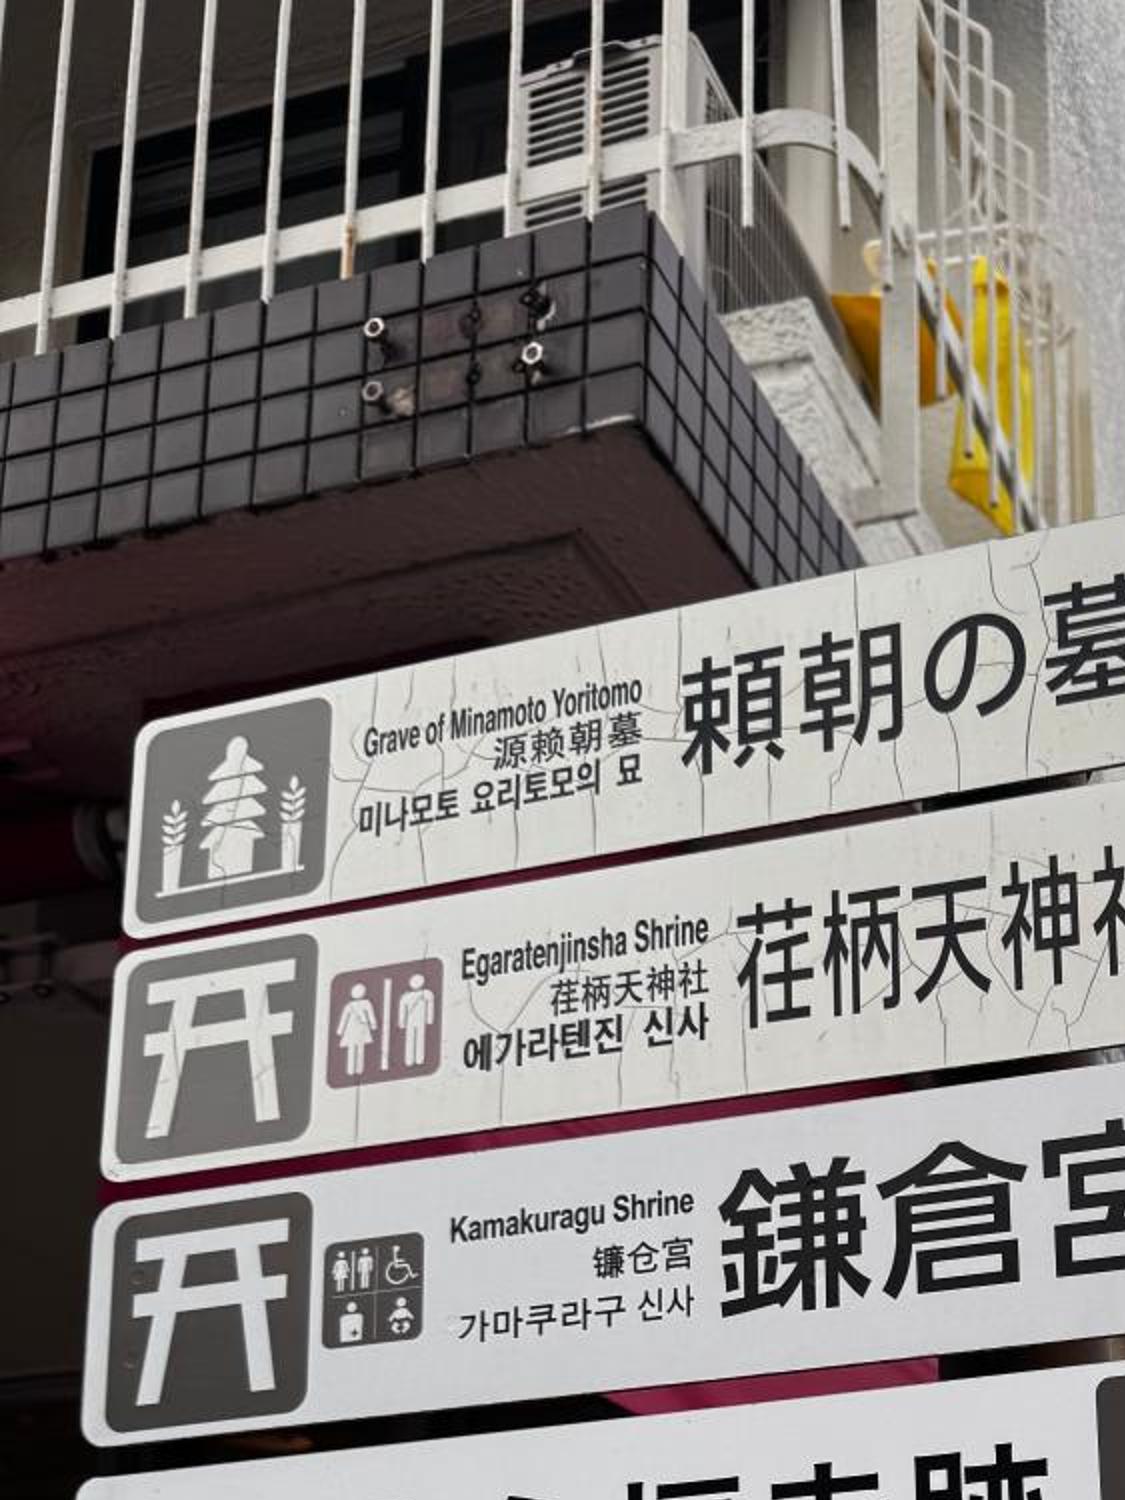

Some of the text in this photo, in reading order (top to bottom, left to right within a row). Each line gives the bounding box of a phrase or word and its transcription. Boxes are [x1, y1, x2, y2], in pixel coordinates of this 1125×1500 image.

[364, 679, 642, 757] Grave of Minamoto Yoritomo
[493, 711, 643, 770] 源赖朝墓
[359, 754, 643, 837] 미나모토 요리토모의 묘
[462, 914, 709, 986] Egaratenjinsha Shrine
[551, 958, 709, 1016] 荏柄天神社
[463, 1001, 709, 1071] 에가라텐진 신사
[450, 1190, 694, 1243] Kamakuragu Shrine
[593, 1236, 693, 1279] 镰仓宫
[458, 1284, 694, 1342] 가마쿠라구 신사
